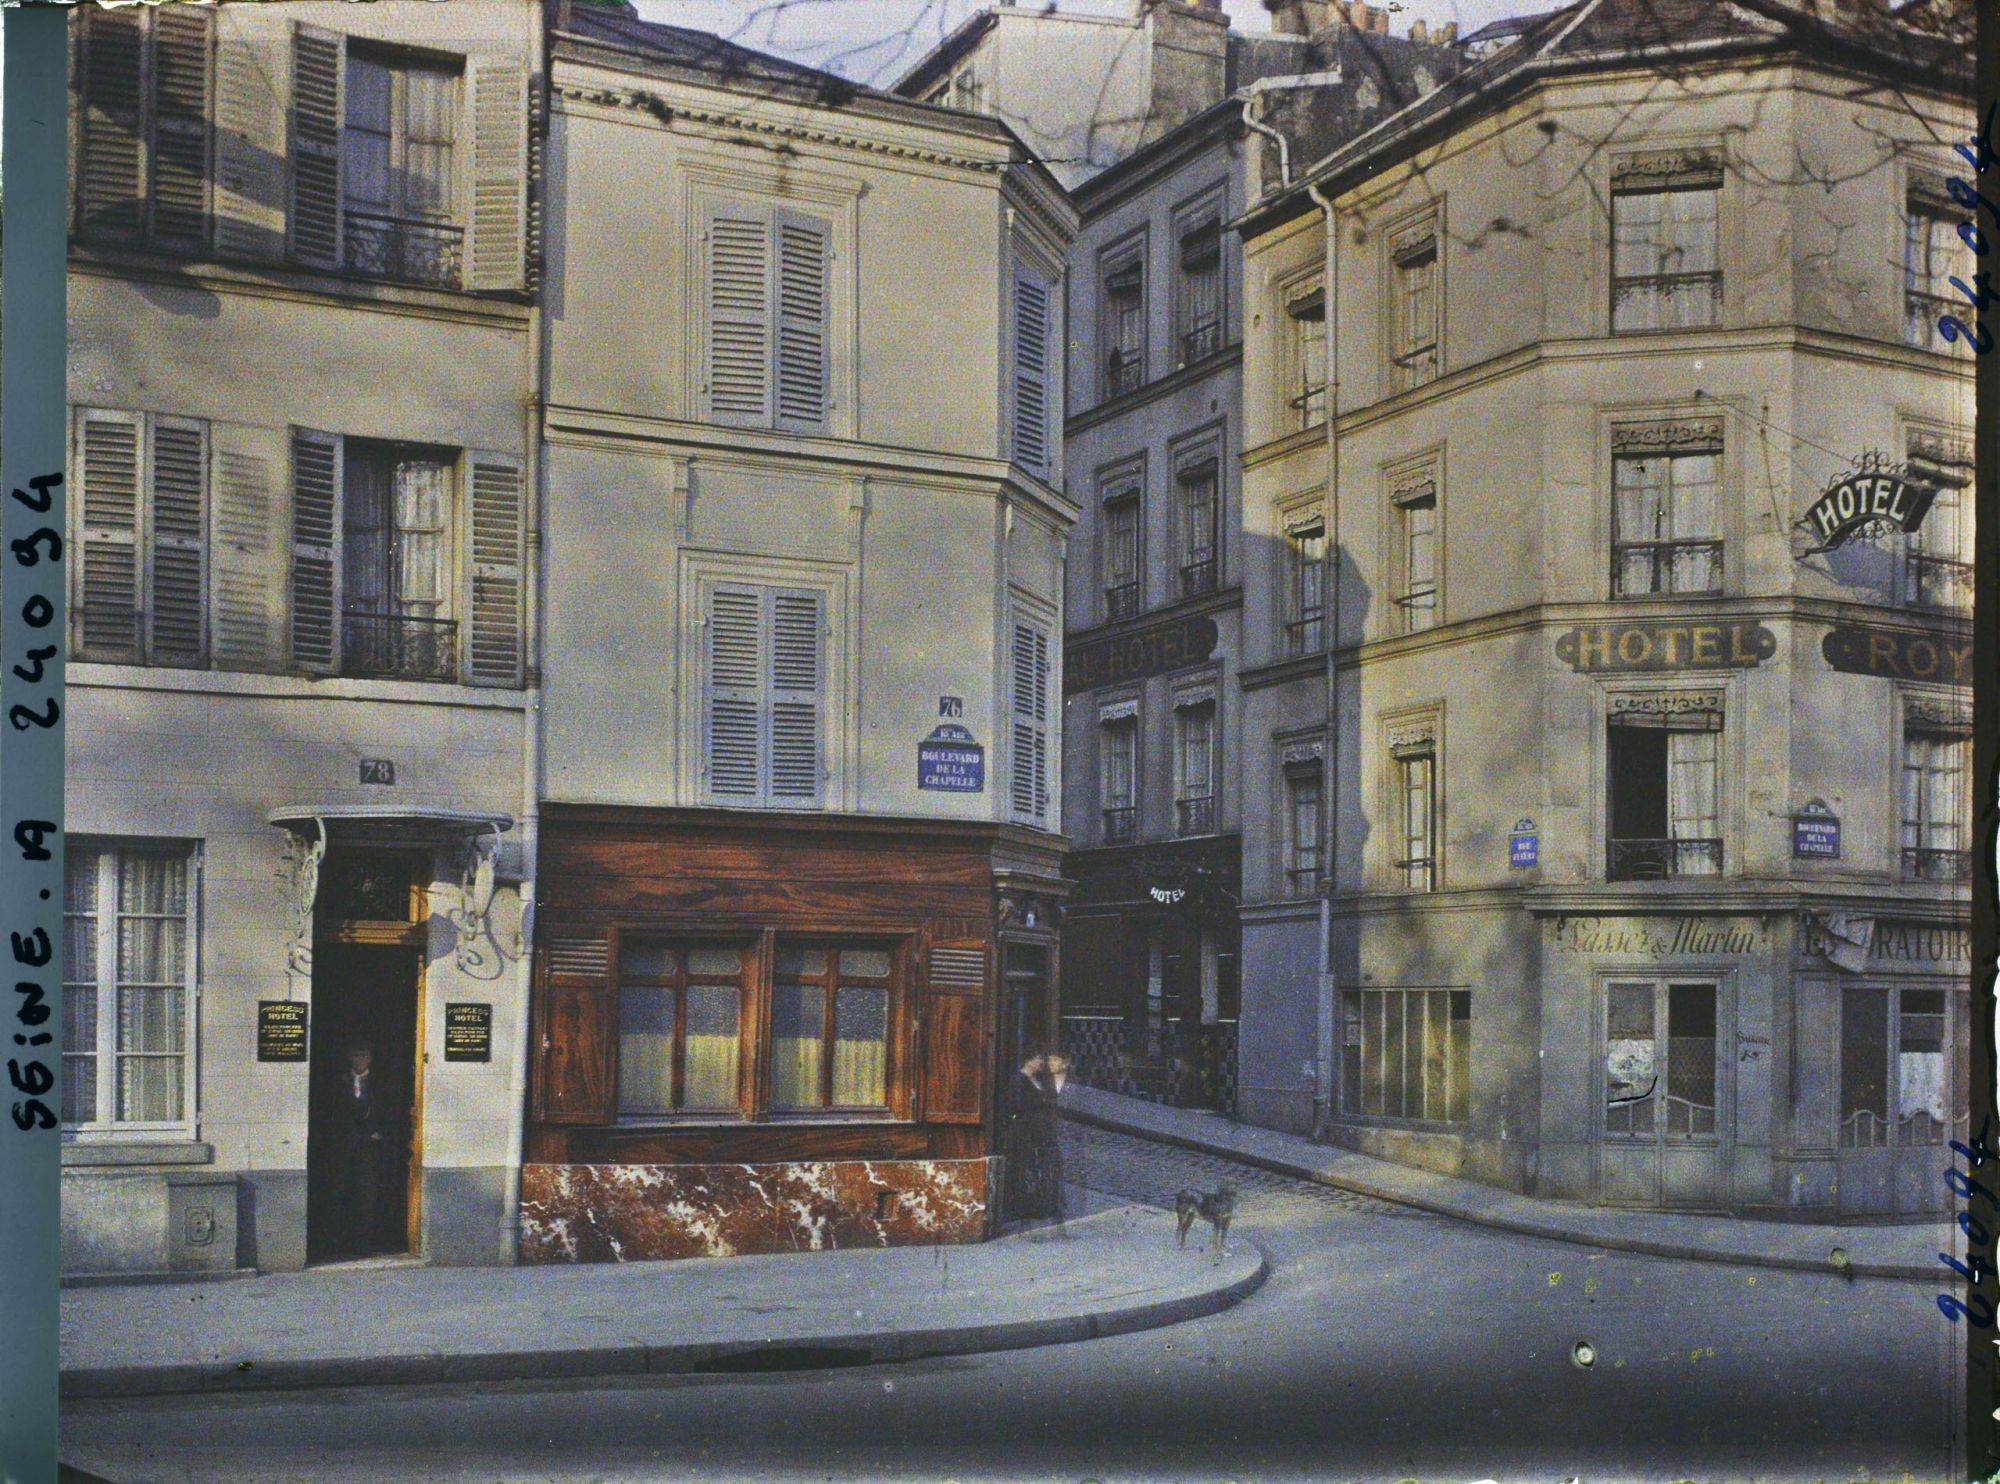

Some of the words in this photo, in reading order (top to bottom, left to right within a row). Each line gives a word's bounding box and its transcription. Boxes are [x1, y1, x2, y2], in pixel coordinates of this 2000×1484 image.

[1938, 98, 2000, 355] 24094
[1816, 469, 1905, 536] HOTEL
[1578, 625, 1757, 667] HOTEL
[942, 698, 961, 717] 76
[921, 751, 980, 764] BOULEVARD
[364, 761, 390, 781] 78
[936, 764, 950, 774] DE
[952, 765, 965, 775] LA
[925, 775, 977, 787] CHAPELLE
[14, 820, 57, 861] A
[1150, 886, 1186, 904] HOTEL
[1937, 1114, 2000, 1329] 24094
